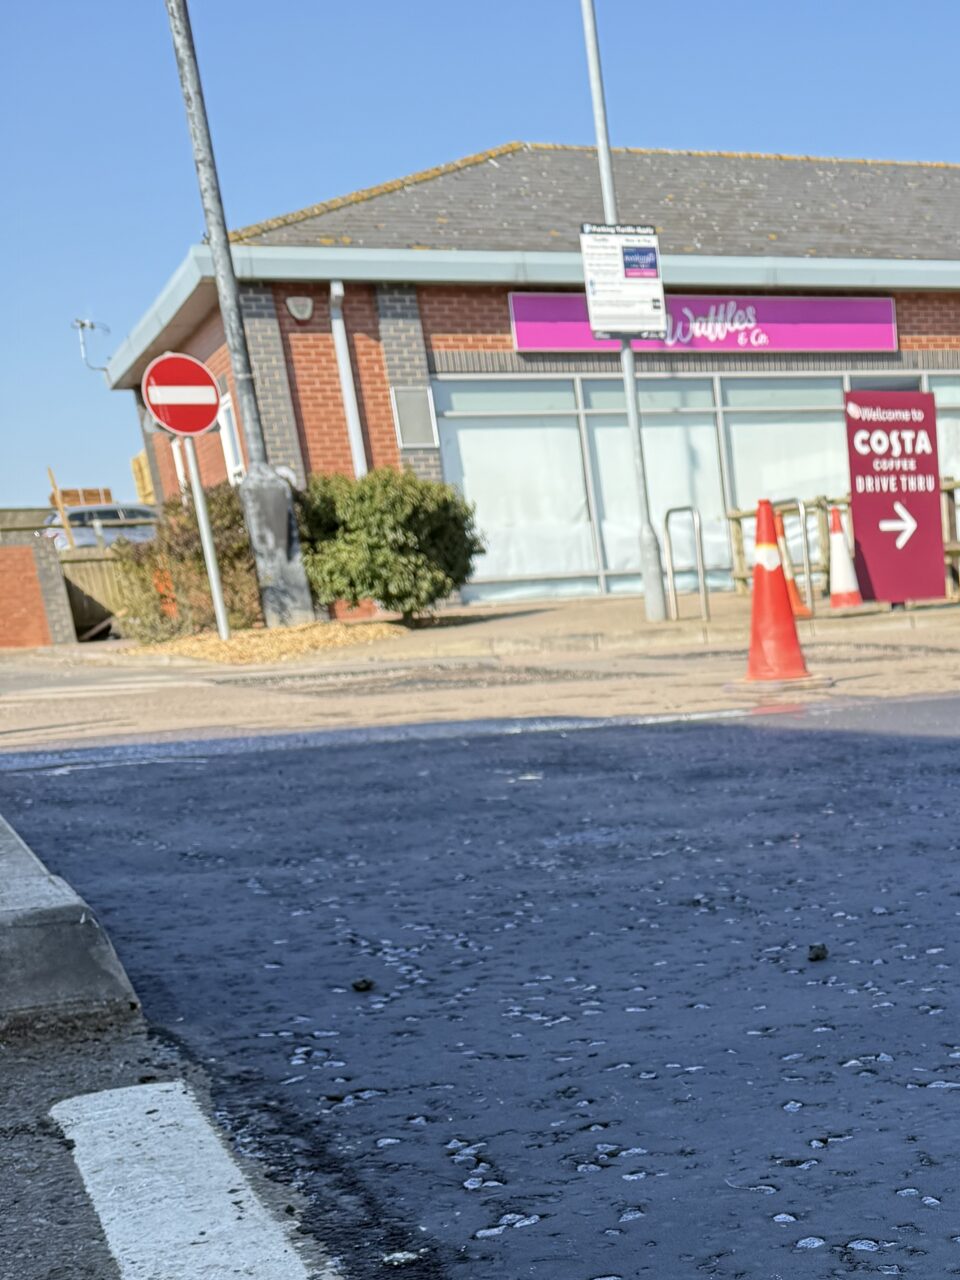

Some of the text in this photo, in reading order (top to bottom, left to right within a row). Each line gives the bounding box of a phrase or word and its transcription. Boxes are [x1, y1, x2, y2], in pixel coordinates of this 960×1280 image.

[664, 300, 756, 346] Waffles
[860, 406, 924, 422] Welcome to
[853, 429, 933, 457] COSTA
[872, 458, 917, 472] COFFEE
[855, 474, 935, 493] DRIVE THRU
